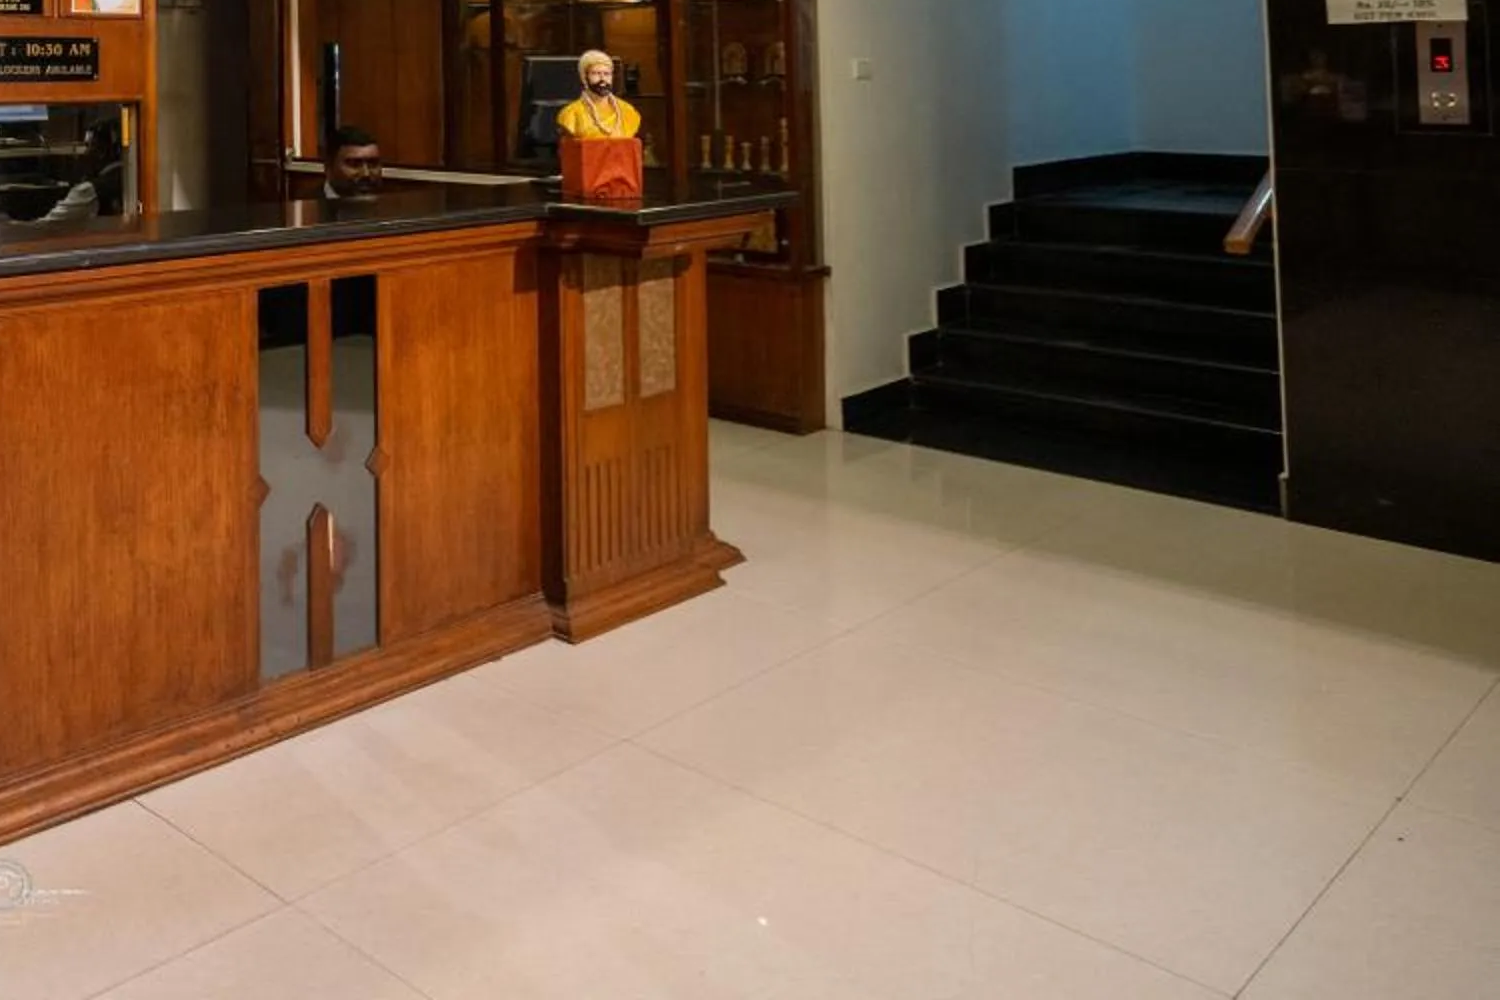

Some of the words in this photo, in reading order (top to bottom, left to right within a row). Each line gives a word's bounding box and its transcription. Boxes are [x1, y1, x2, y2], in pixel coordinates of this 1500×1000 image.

[26, 42, 63, 57] 10:30
[69, 42, 92, 57] AM
[1435, 55, 1450, 69] 3
